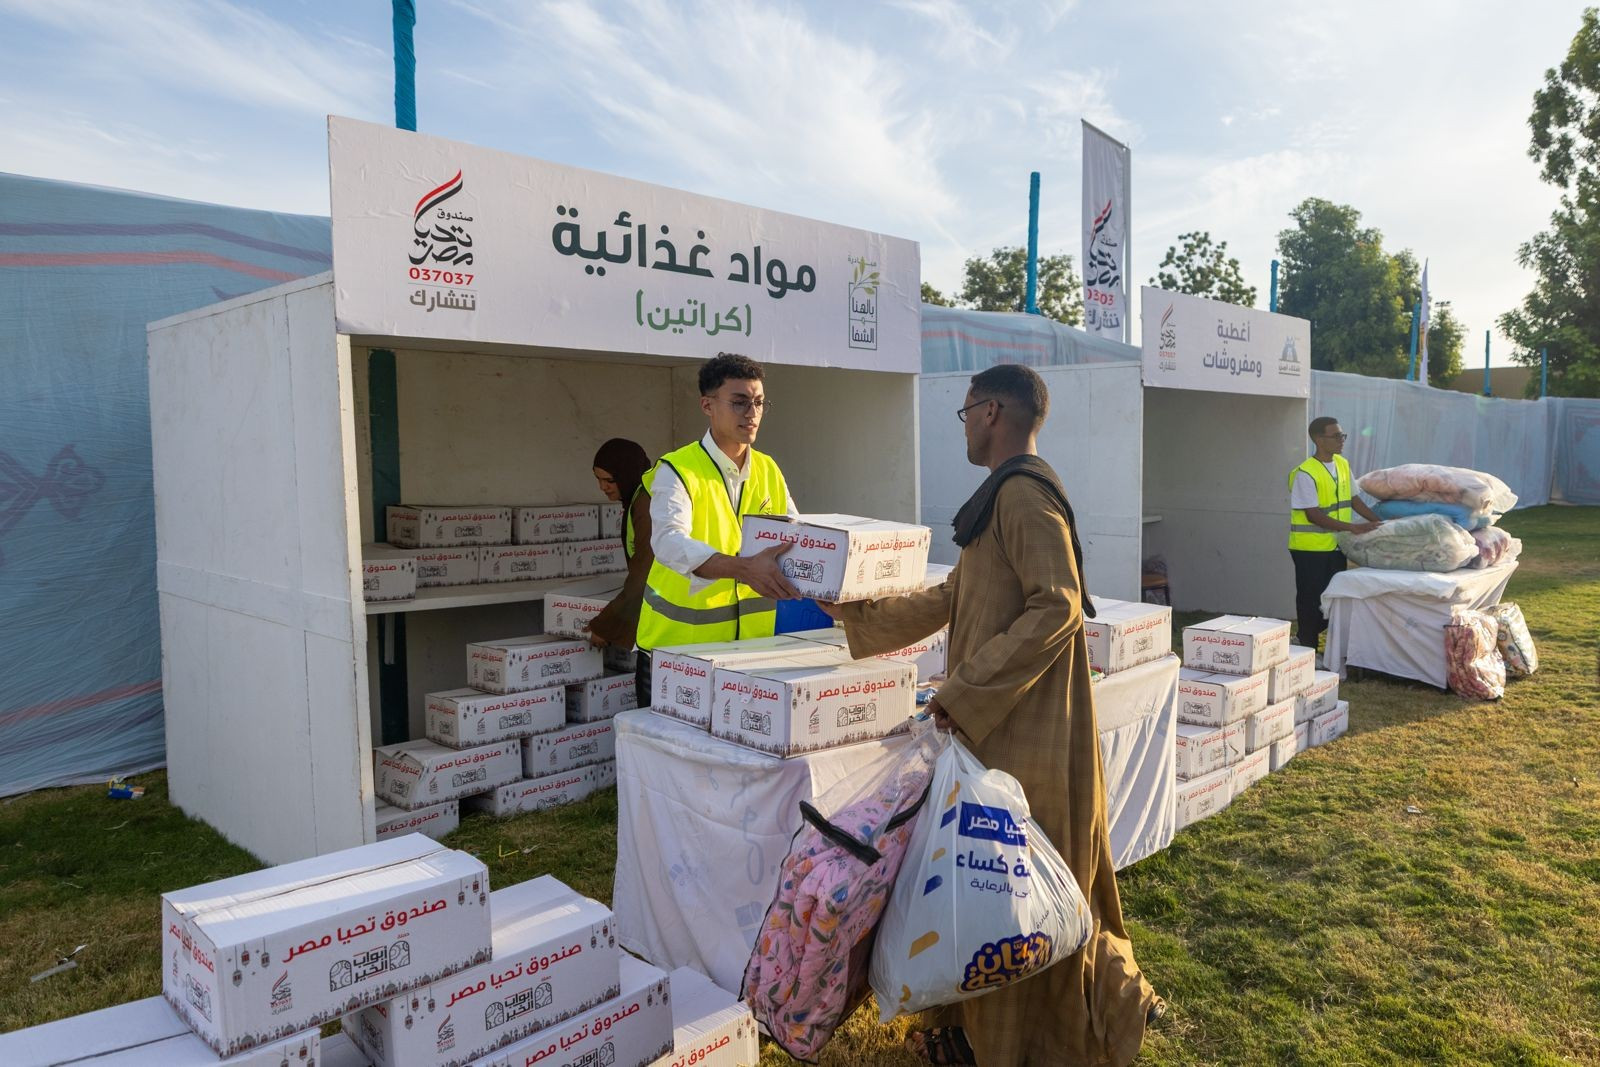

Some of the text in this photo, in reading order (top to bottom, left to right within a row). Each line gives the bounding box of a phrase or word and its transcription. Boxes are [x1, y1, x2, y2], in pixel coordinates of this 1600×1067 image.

[437, 208, 474, 222] صندوق
[552, 205, 817, 299] مواد غذائية
[409, 267, 474, 286] 037037
[409, 289, 476, 312] نتشارك
[851, 297, 875, 317] بالهنا
[636, 289, 752, 337] (كراتين)
[851, 325, 875, 343] الشفا
[1217, 319, 1250, 344] أغطية
[1203, 348, 1262, 378] ومفروشات
[755, 530, 837, 551] صندوق تحيا مصر
[864, 538, 915, 554] صندوق تحيا مصر
[367, 564, 397, 573] صندوق
[901, 643, 928, 656] صندوق
[1207, 636, 1221, 644] تحيا
[1221, 638, 1245, 647] صندوق
[526, 647, 585, 662] صندوق تحيا مصر
[659, 660, 706, 678] صندوق تحيا مصر
[721, 681, 779, 701] صندوق تحيا مصر
[816, 679, 896, 701] صندوق تحيا مصر
[1179, 685, 1217, 697] صندوق تحيا
[482, 696, 547, 714] صندوق تحيا مصر
[553, 725, 611, 745] صندوق تحيا مصر
[434, 750, 501, 772] صندوق تحيا مصر
[520, 775, 580, 798] صندوق تحيا مصر
[390, 820, 408, 832] تحيا
[409, 812, 439, 827] صندوق
[968, 816, 1000, 831] مصر
[956, 850, 1008, 875] كساء
[970, 877, 1014, 895] بالرعاية
[282, 899, 447, 963] صندوق تحيا مصر
[168, 922, 215, 973] صندوق تحيا مصر
[352, 945, 388, 967] أبواب
[353, 961, 389, 984] الخير
[445, 943, 582, 1008] صندوق تحيا مصر
[504, 990, 533, 1008] أبواب
[505, 1000, 534, 1022] الخير
[524, 1002, 640, 1067] صندوق تحيا مصر
[687, 1034, 730, 1066] صندوق
